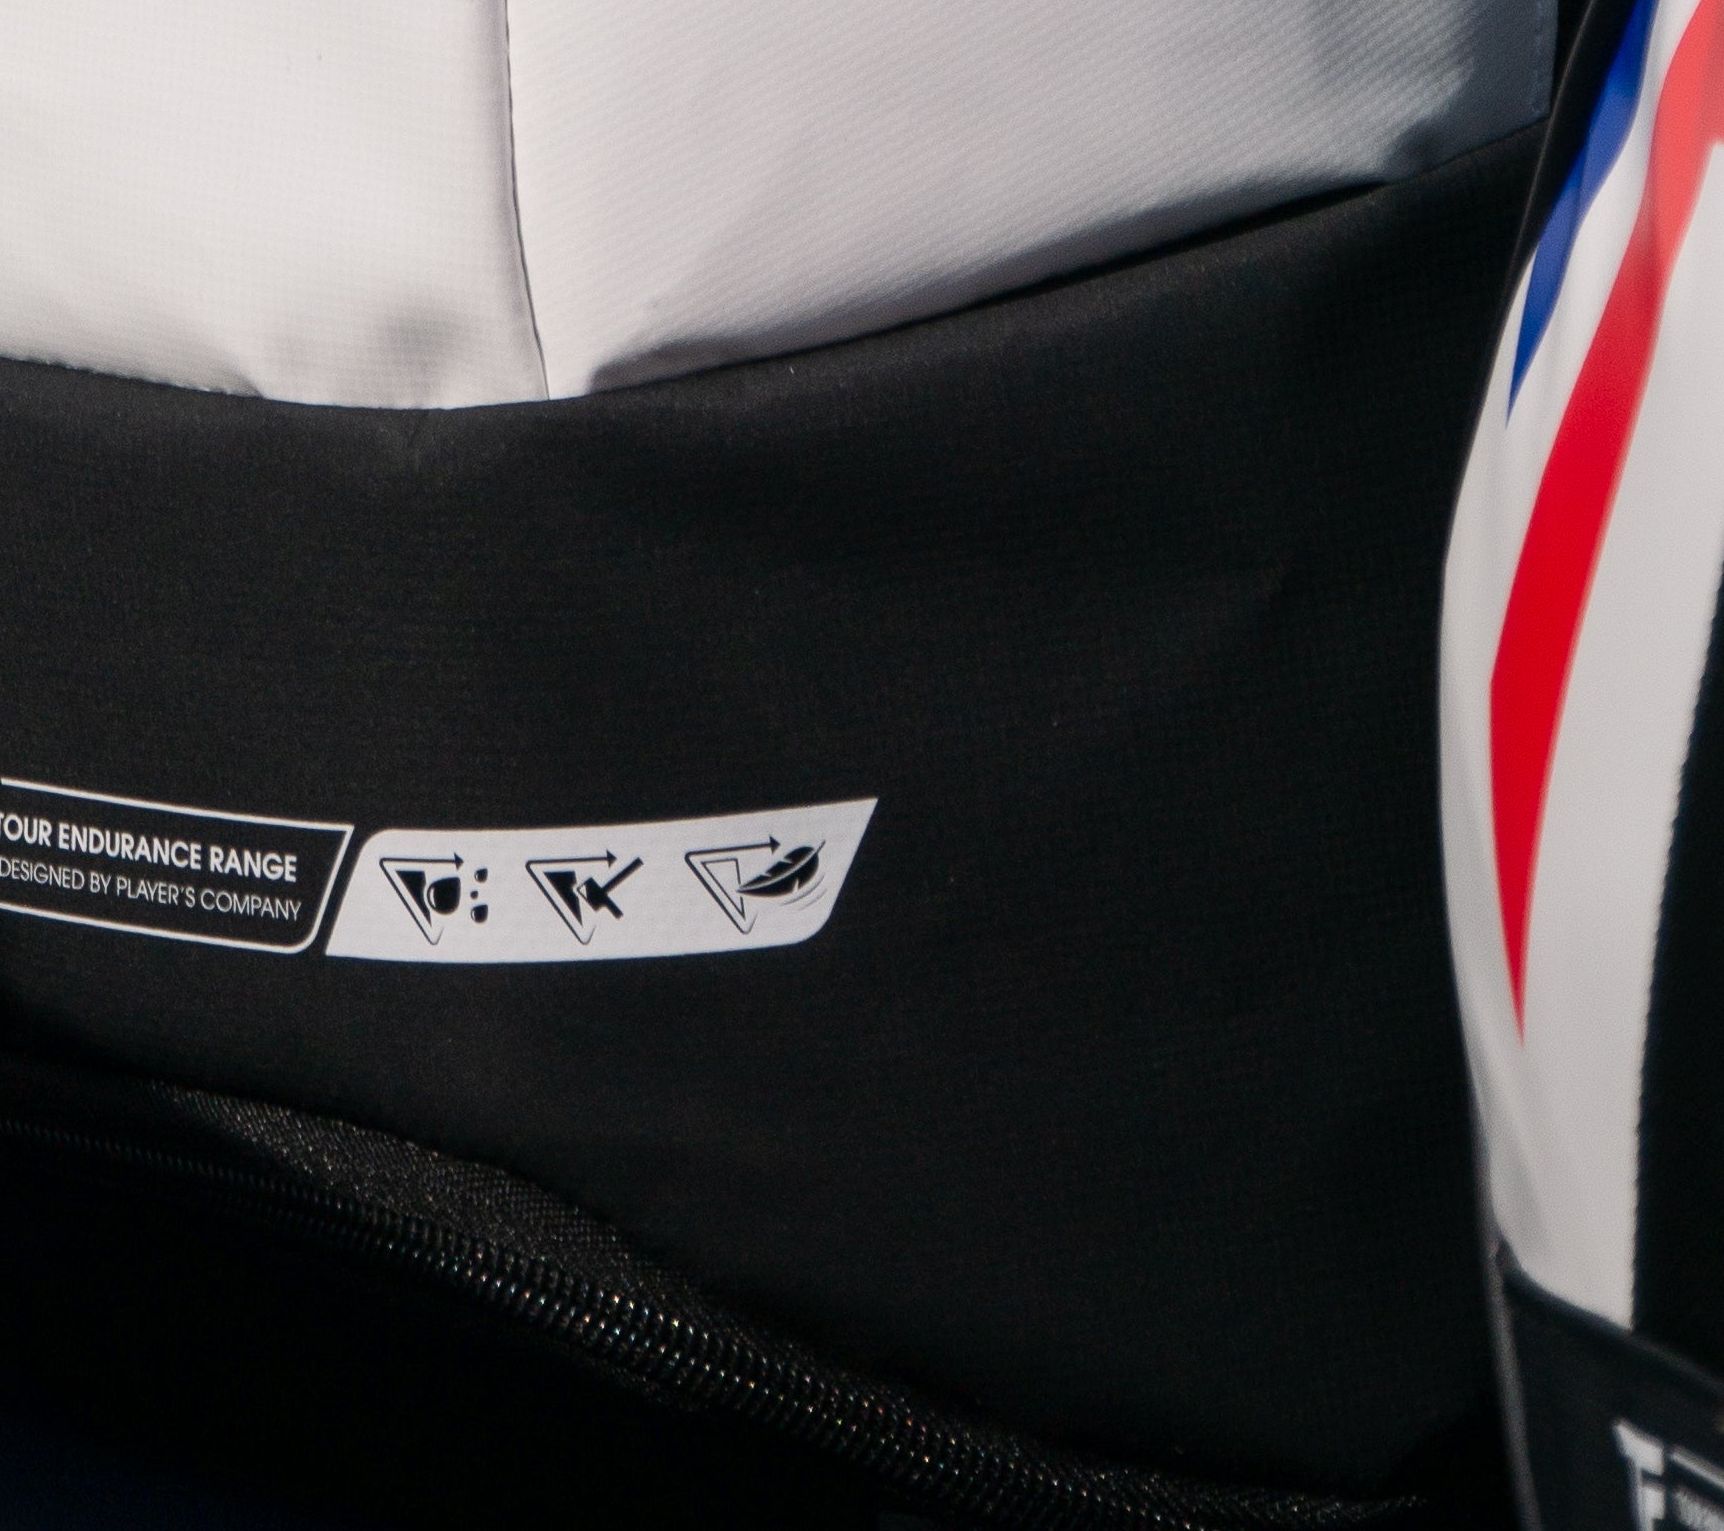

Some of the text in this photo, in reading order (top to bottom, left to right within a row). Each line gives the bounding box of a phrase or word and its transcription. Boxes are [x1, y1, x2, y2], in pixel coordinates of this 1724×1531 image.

[57, 821, 202, 870] ENDURANCE
[209, 844, 298, 883] RANGE
[88, 871, 112, 895] BY
[200, 888, 302, 922] COMPANY
